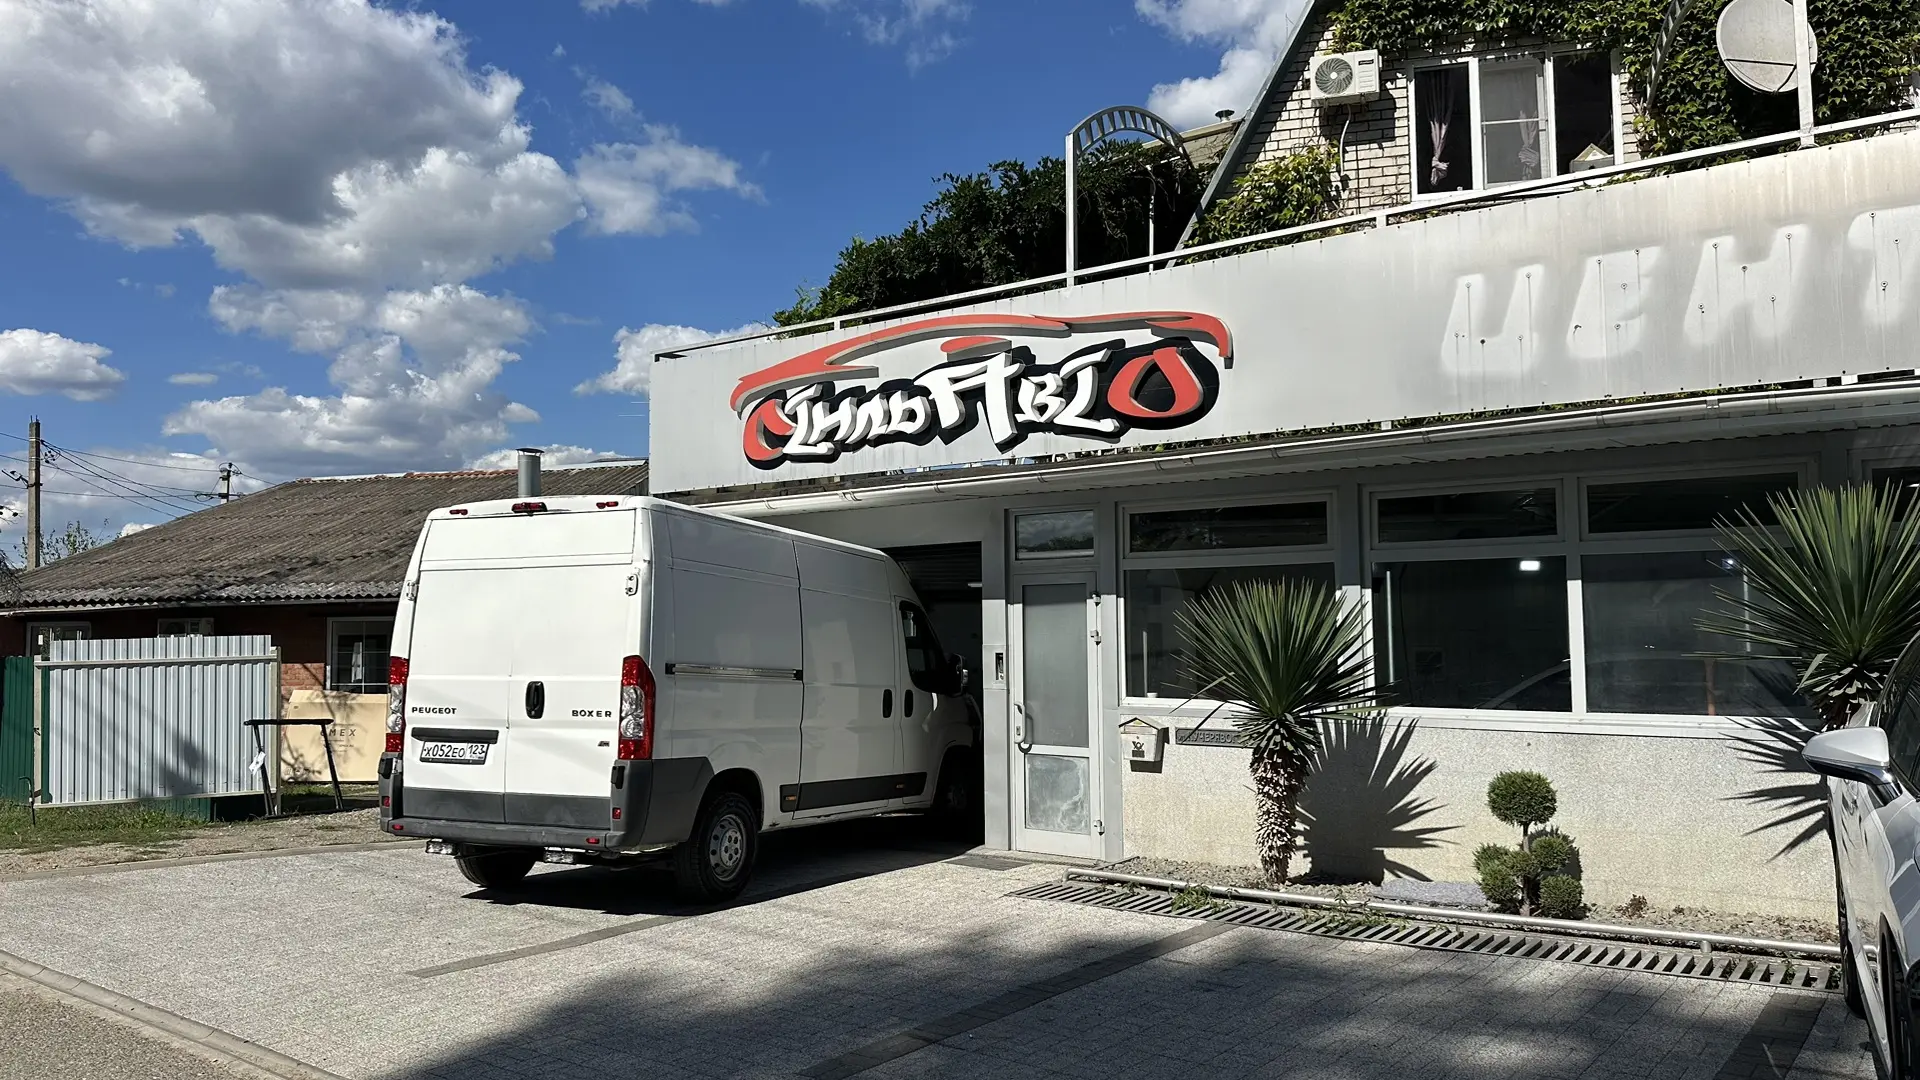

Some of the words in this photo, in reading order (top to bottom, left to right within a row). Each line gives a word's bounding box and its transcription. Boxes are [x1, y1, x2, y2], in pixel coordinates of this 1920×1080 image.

[411, 706, 457, 715] PEUGEOT
[571, 709, 612, 718] BOXER
[468, 744, 485, 755] 123
